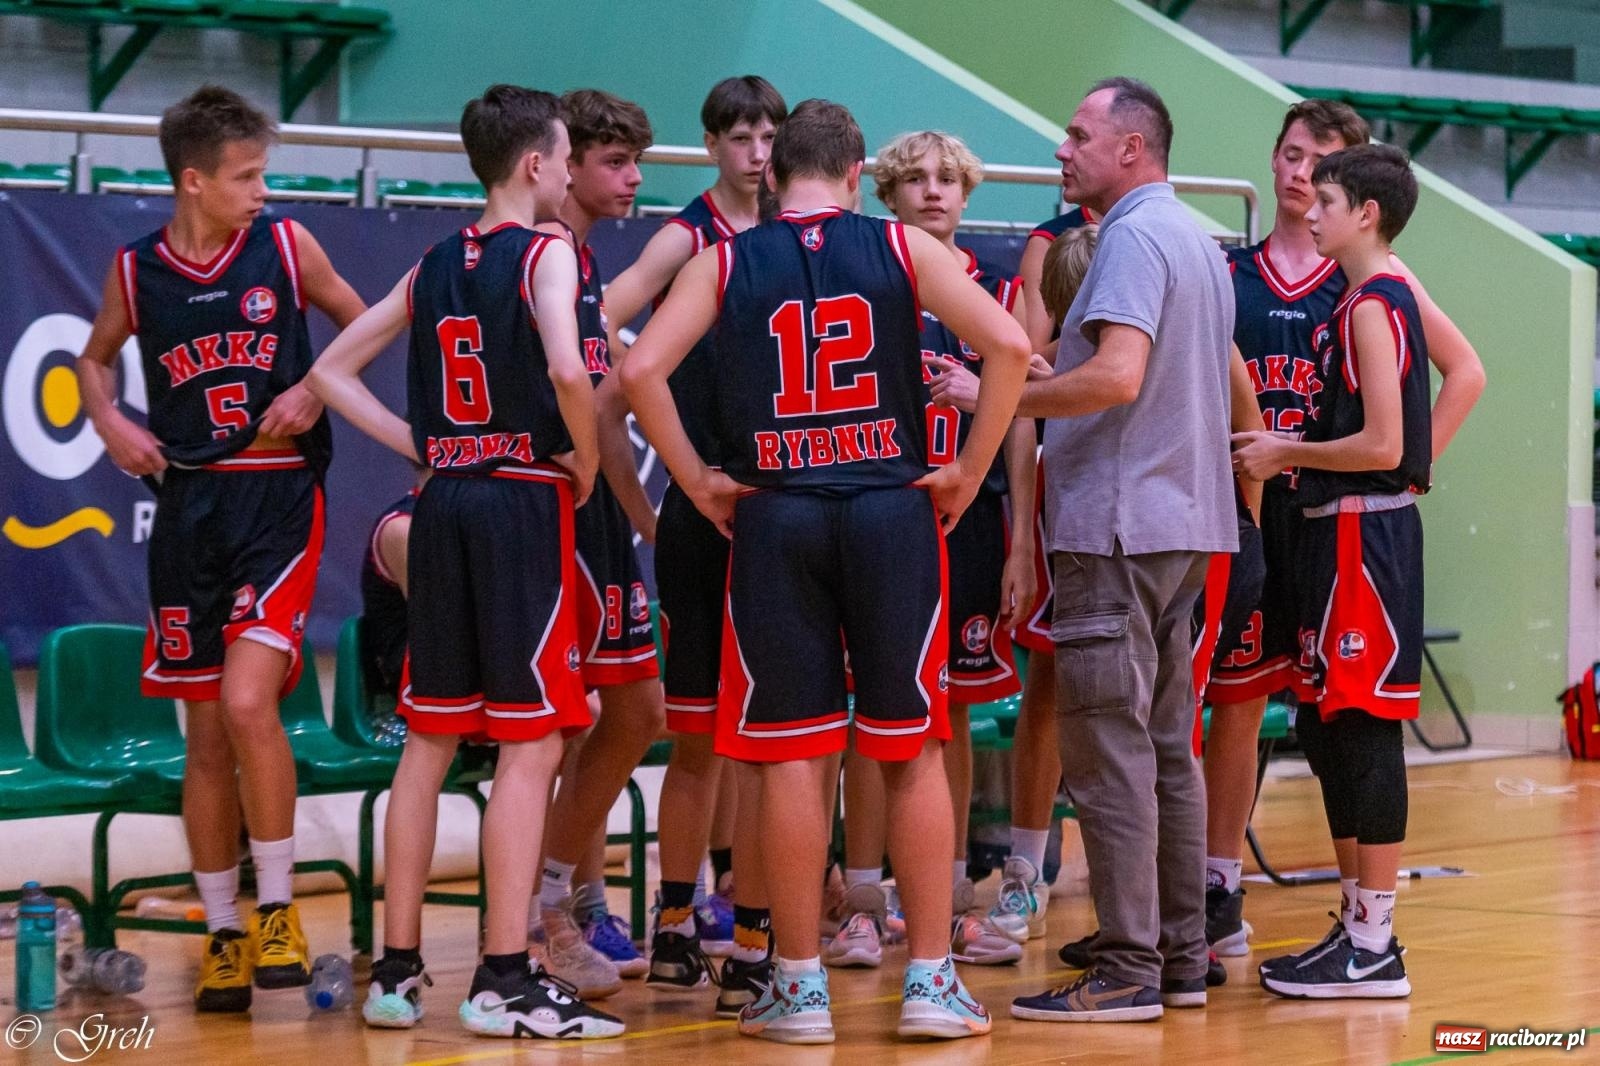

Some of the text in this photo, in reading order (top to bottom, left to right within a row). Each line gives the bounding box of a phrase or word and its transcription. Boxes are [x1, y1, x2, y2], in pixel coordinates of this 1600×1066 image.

[1269, 309, 1307, 320] regio
[159, 331, 279, 388] MKKS
[436, 315, 493, 425] 6
[768, 293, 879, 418] 12
[205, 382, 250, 440] 5
[755, 418, 901, 470] RYBNIK
[159, 606, 193, 661] 5
[606, 585, 623, 640] 8
